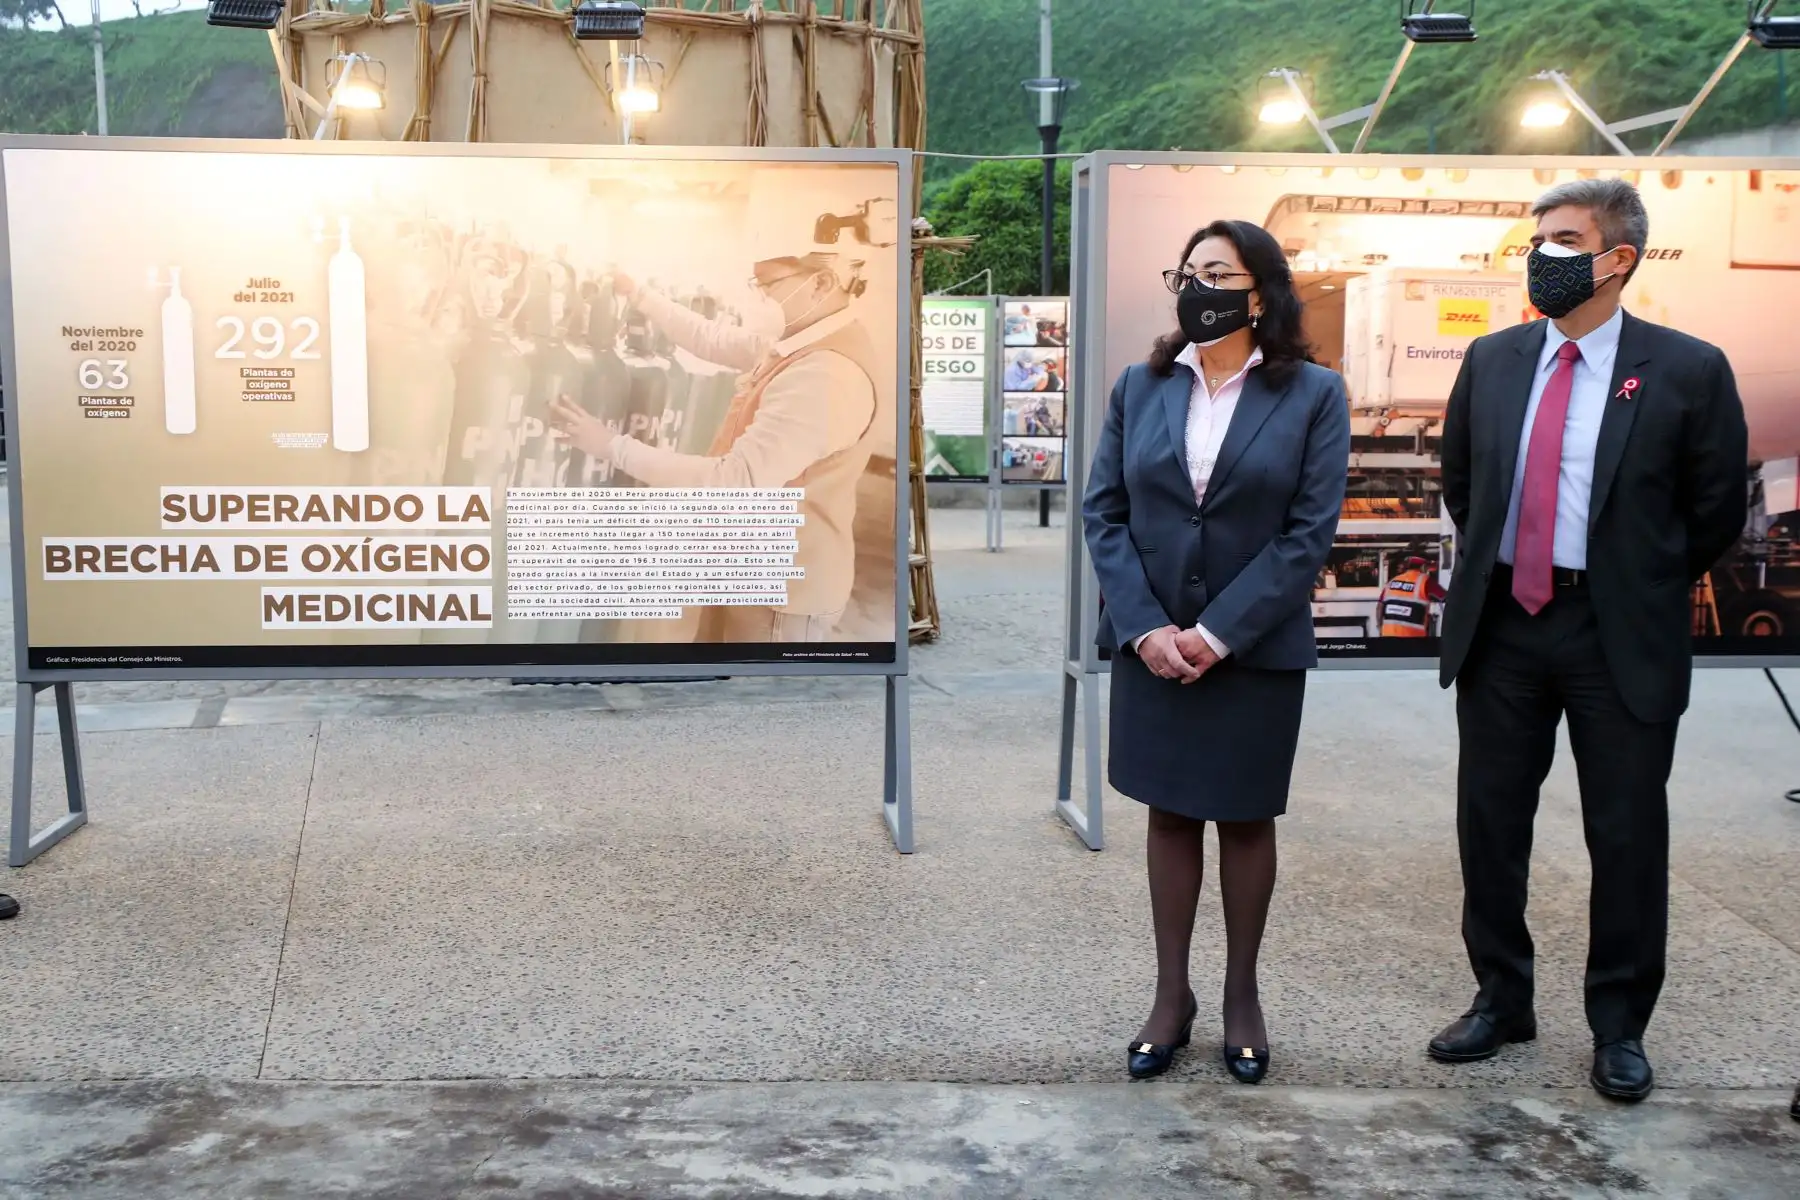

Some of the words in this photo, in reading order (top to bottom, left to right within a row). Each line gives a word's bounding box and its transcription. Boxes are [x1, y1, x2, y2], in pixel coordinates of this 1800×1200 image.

[246, 277, 281, 289] Julio
[233, 291, 256, 303] del
[260, 291, 294, 303] 2021
[1445, 312, 1482, 322] DHL
[62, 326, 144, 338] Noviembre
[214, 316, 322, 360] 292
[70, 340, 93, 352] del
[97, 340, 136, 352] 2020
[952, 336, 976, 350] DE
[78, 358, 130, 390] 63
[243, 368, 277, 378] Plantas
[280, 368, 293, 378] de
[249, 380, 288, 390] oxígeno
[81, 396, 117, 406] Plantas
[120, 396, 132, 406] de
[242, 392, 293, 402] operativas
[88, 408, 128, 418] oxígeno
[162, 494, 424, 523] SUPERANDO
[438, 494, 490, 522] LA
[45, 544, 221, 574] BRECHA
[234, 544, 288, 573] DE
[301, 537, 490, 573] OXÍGENO
[264, 594, 492, 622] MEDICINAL
